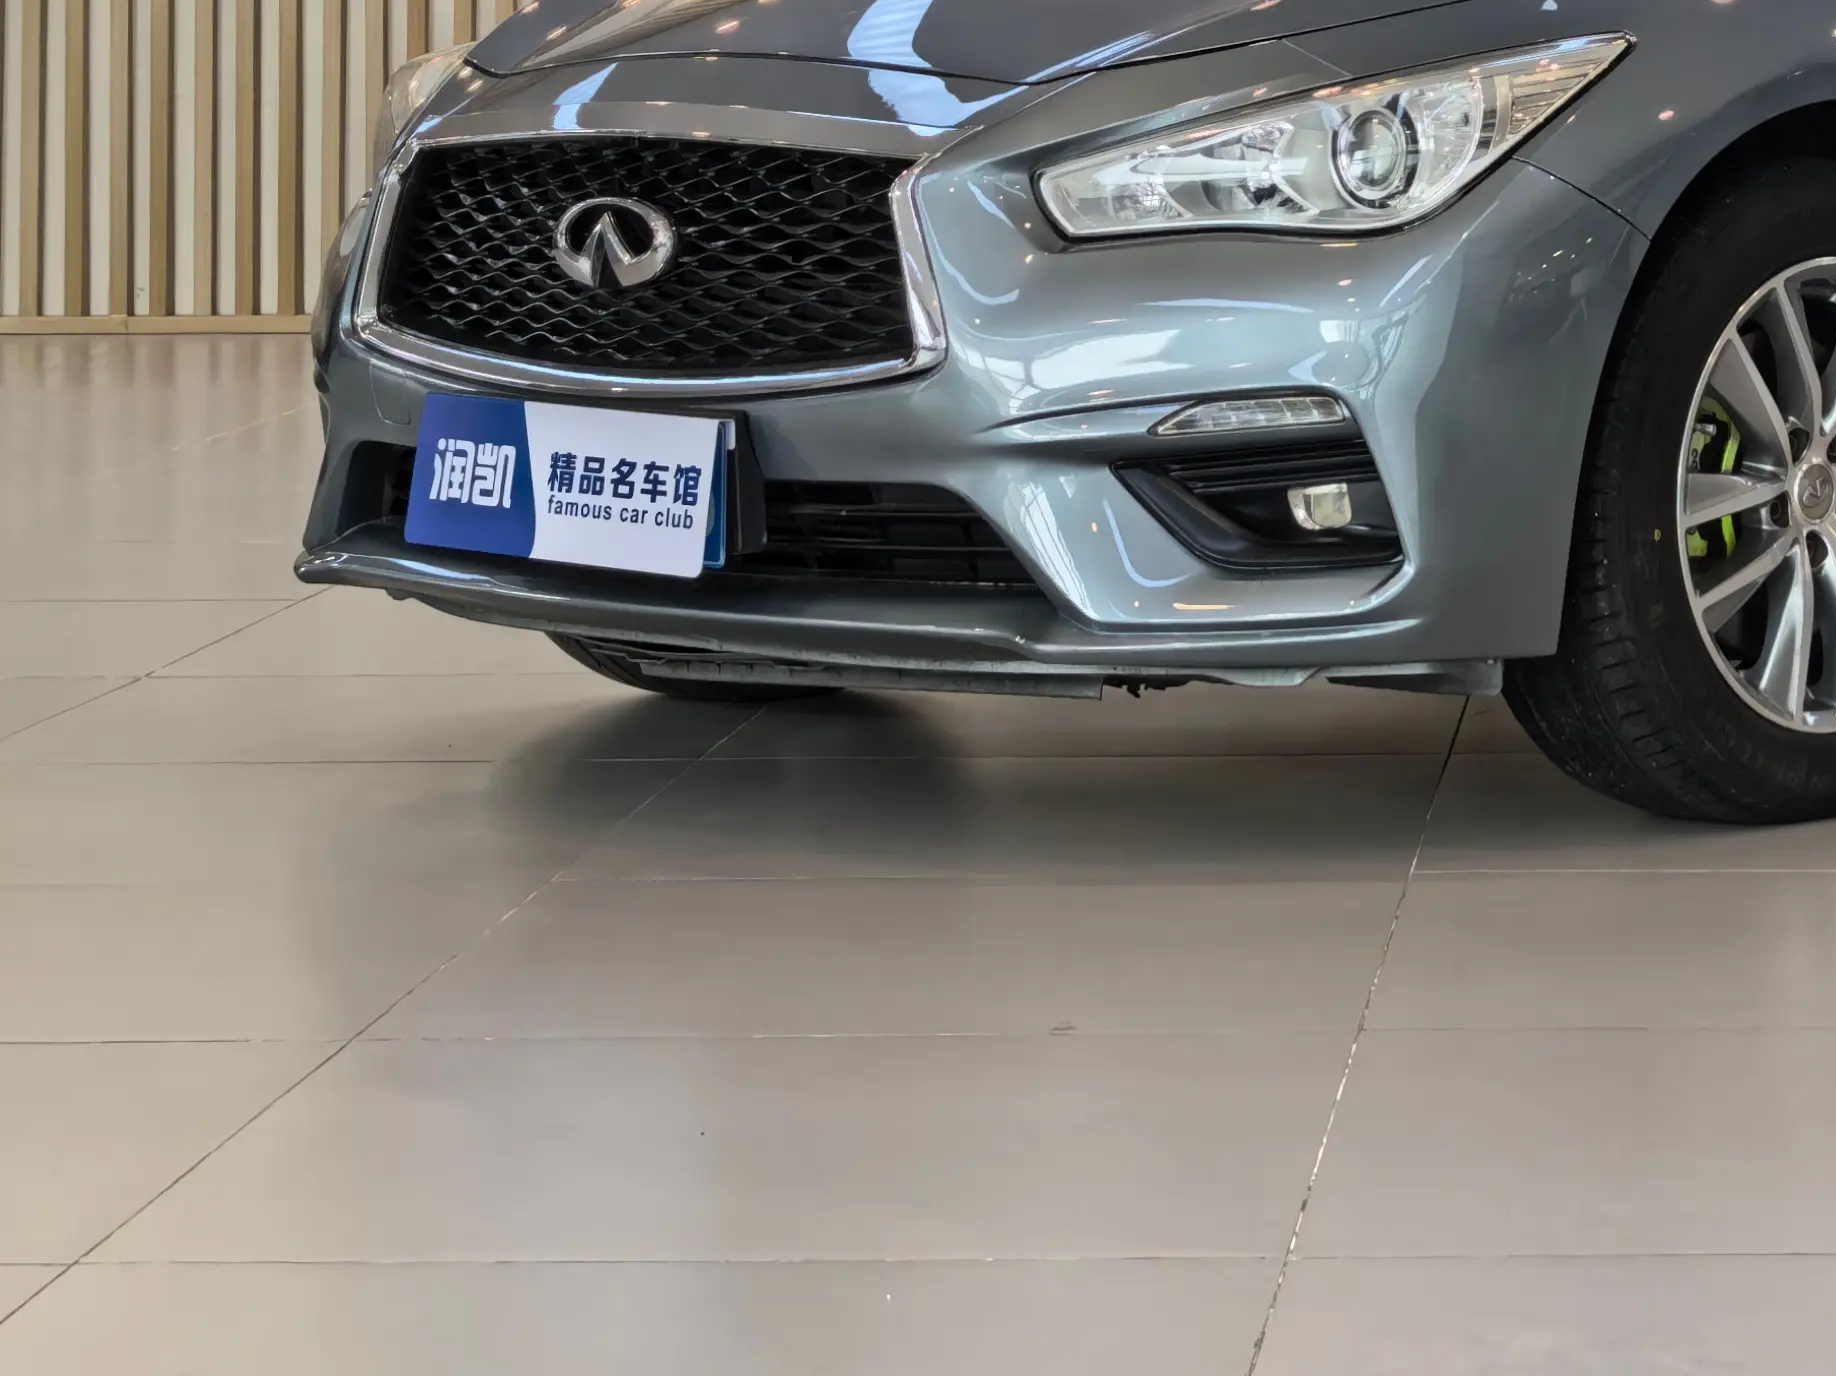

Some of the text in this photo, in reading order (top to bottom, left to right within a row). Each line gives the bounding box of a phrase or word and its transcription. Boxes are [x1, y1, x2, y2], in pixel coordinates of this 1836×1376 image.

[429, 438, 517, 509] 润凯
[548, 451, 702, 507] 精品名车馆
[548, 494, 694, 530] famous car club
